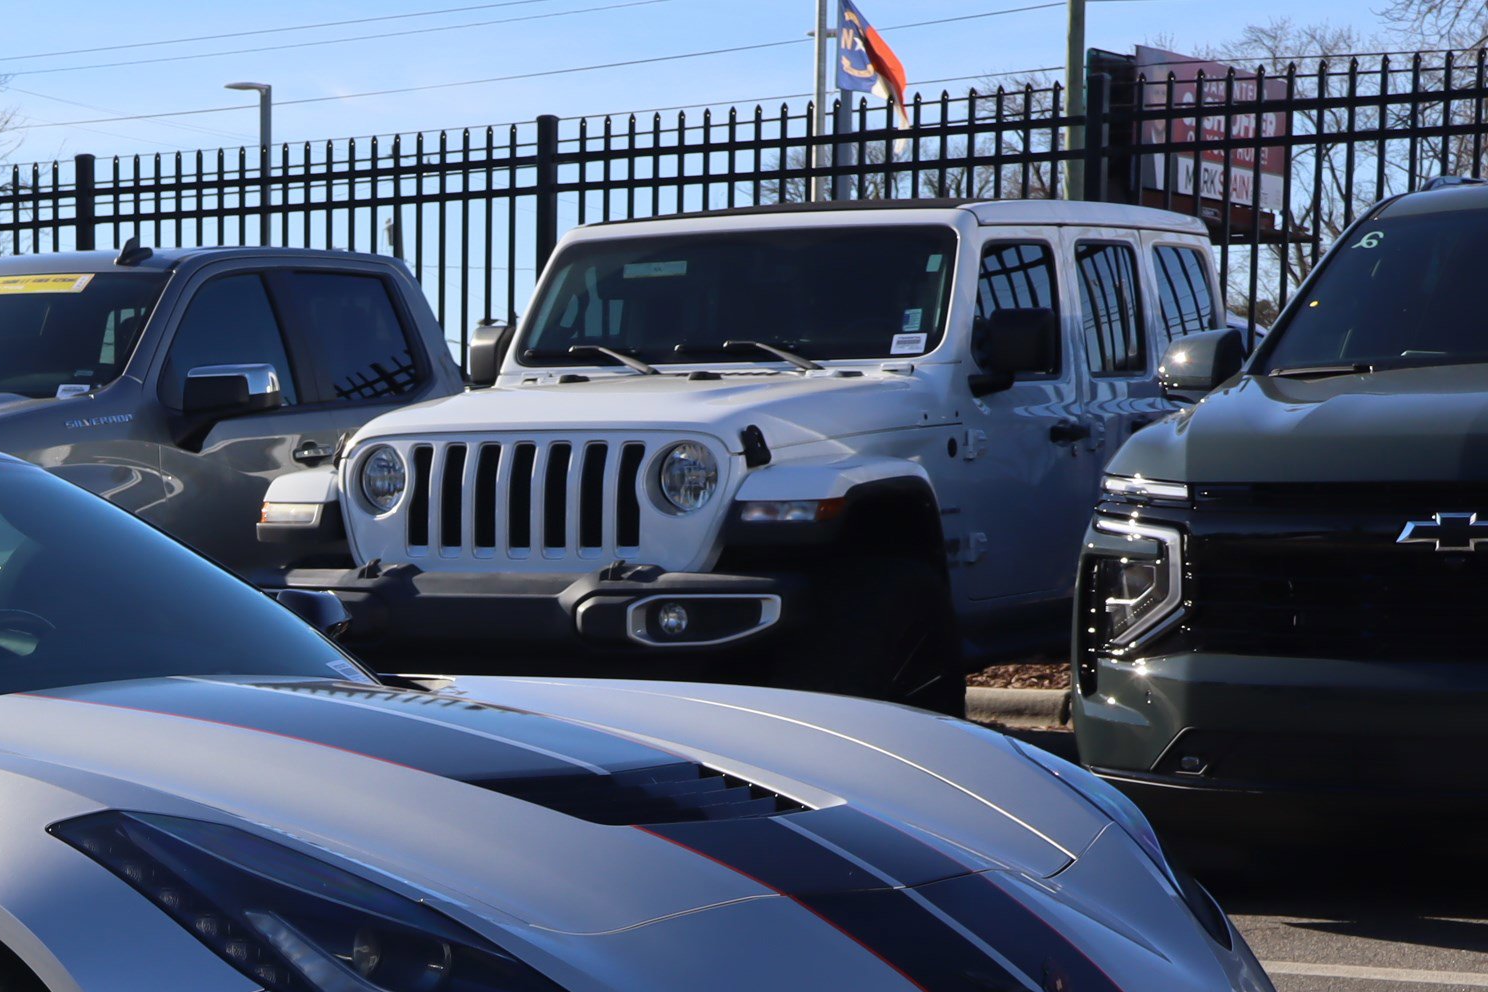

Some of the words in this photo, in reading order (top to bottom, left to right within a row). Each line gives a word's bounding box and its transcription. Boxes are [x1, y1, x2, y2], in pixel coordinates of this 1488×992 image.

[1183, 91, 1226, 132] CSH
[1185, 163, 1217, 198] MRK
[1218, 169, 1251, 204] SAIN
